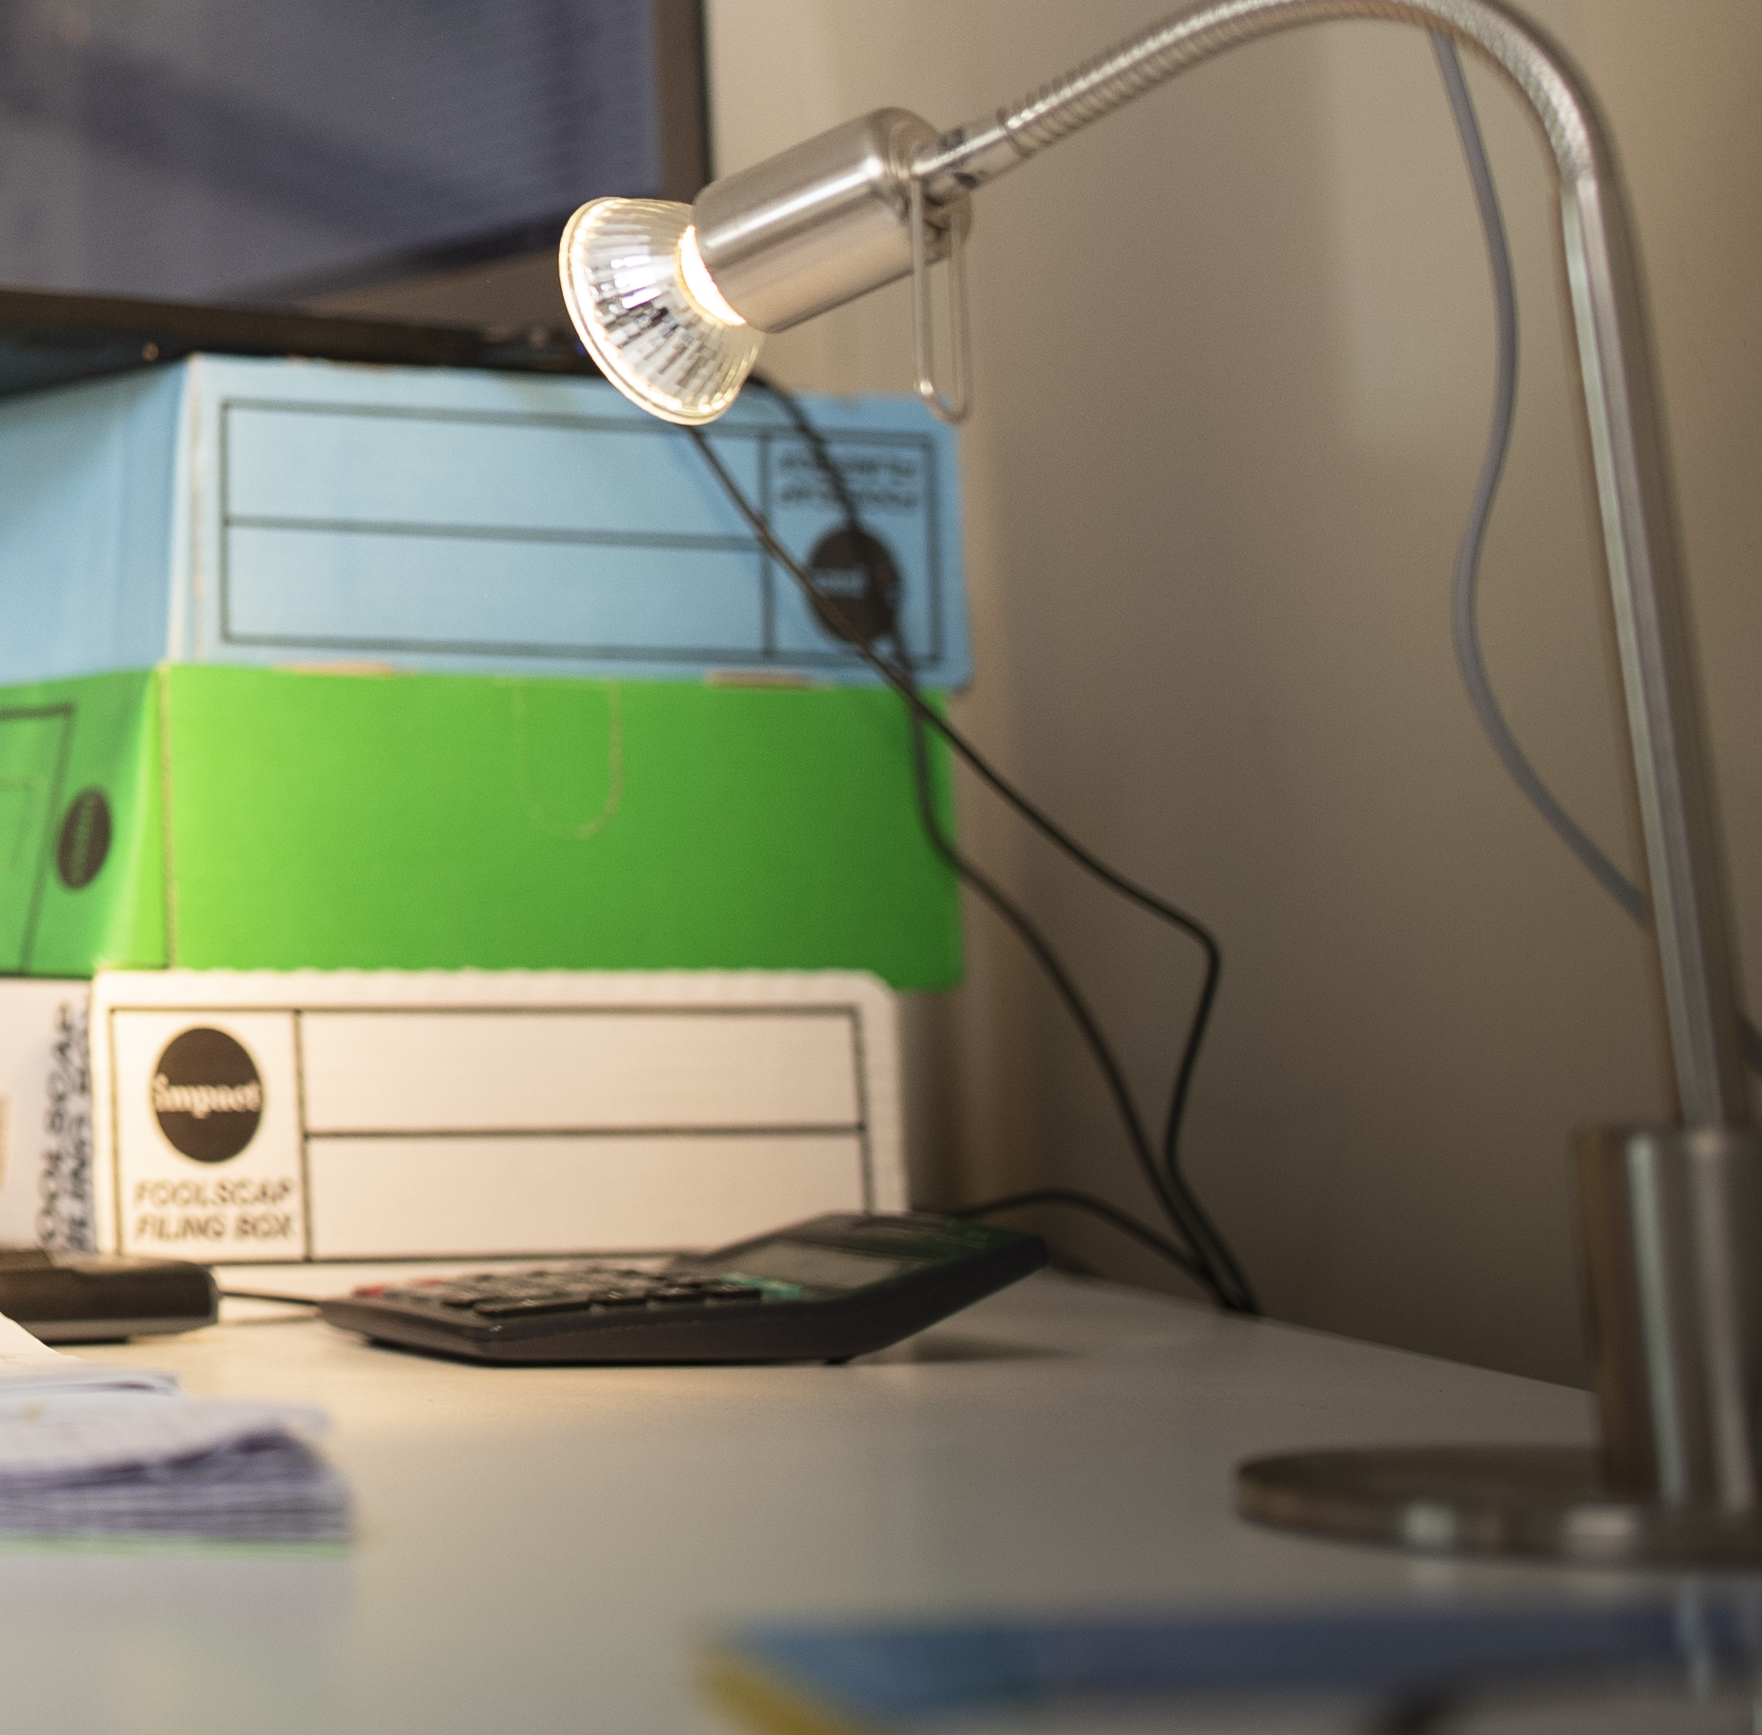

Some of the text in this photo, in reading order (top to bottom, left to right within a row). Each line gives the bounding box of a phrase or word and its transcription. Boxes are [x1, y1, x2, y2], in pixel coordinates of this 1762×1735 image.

[154, 1072, 262, 1119] Impact
[134, 1177, 293, 1207] FOOLSCAP
[134, 1213, 292, 1241] FILING BOX
